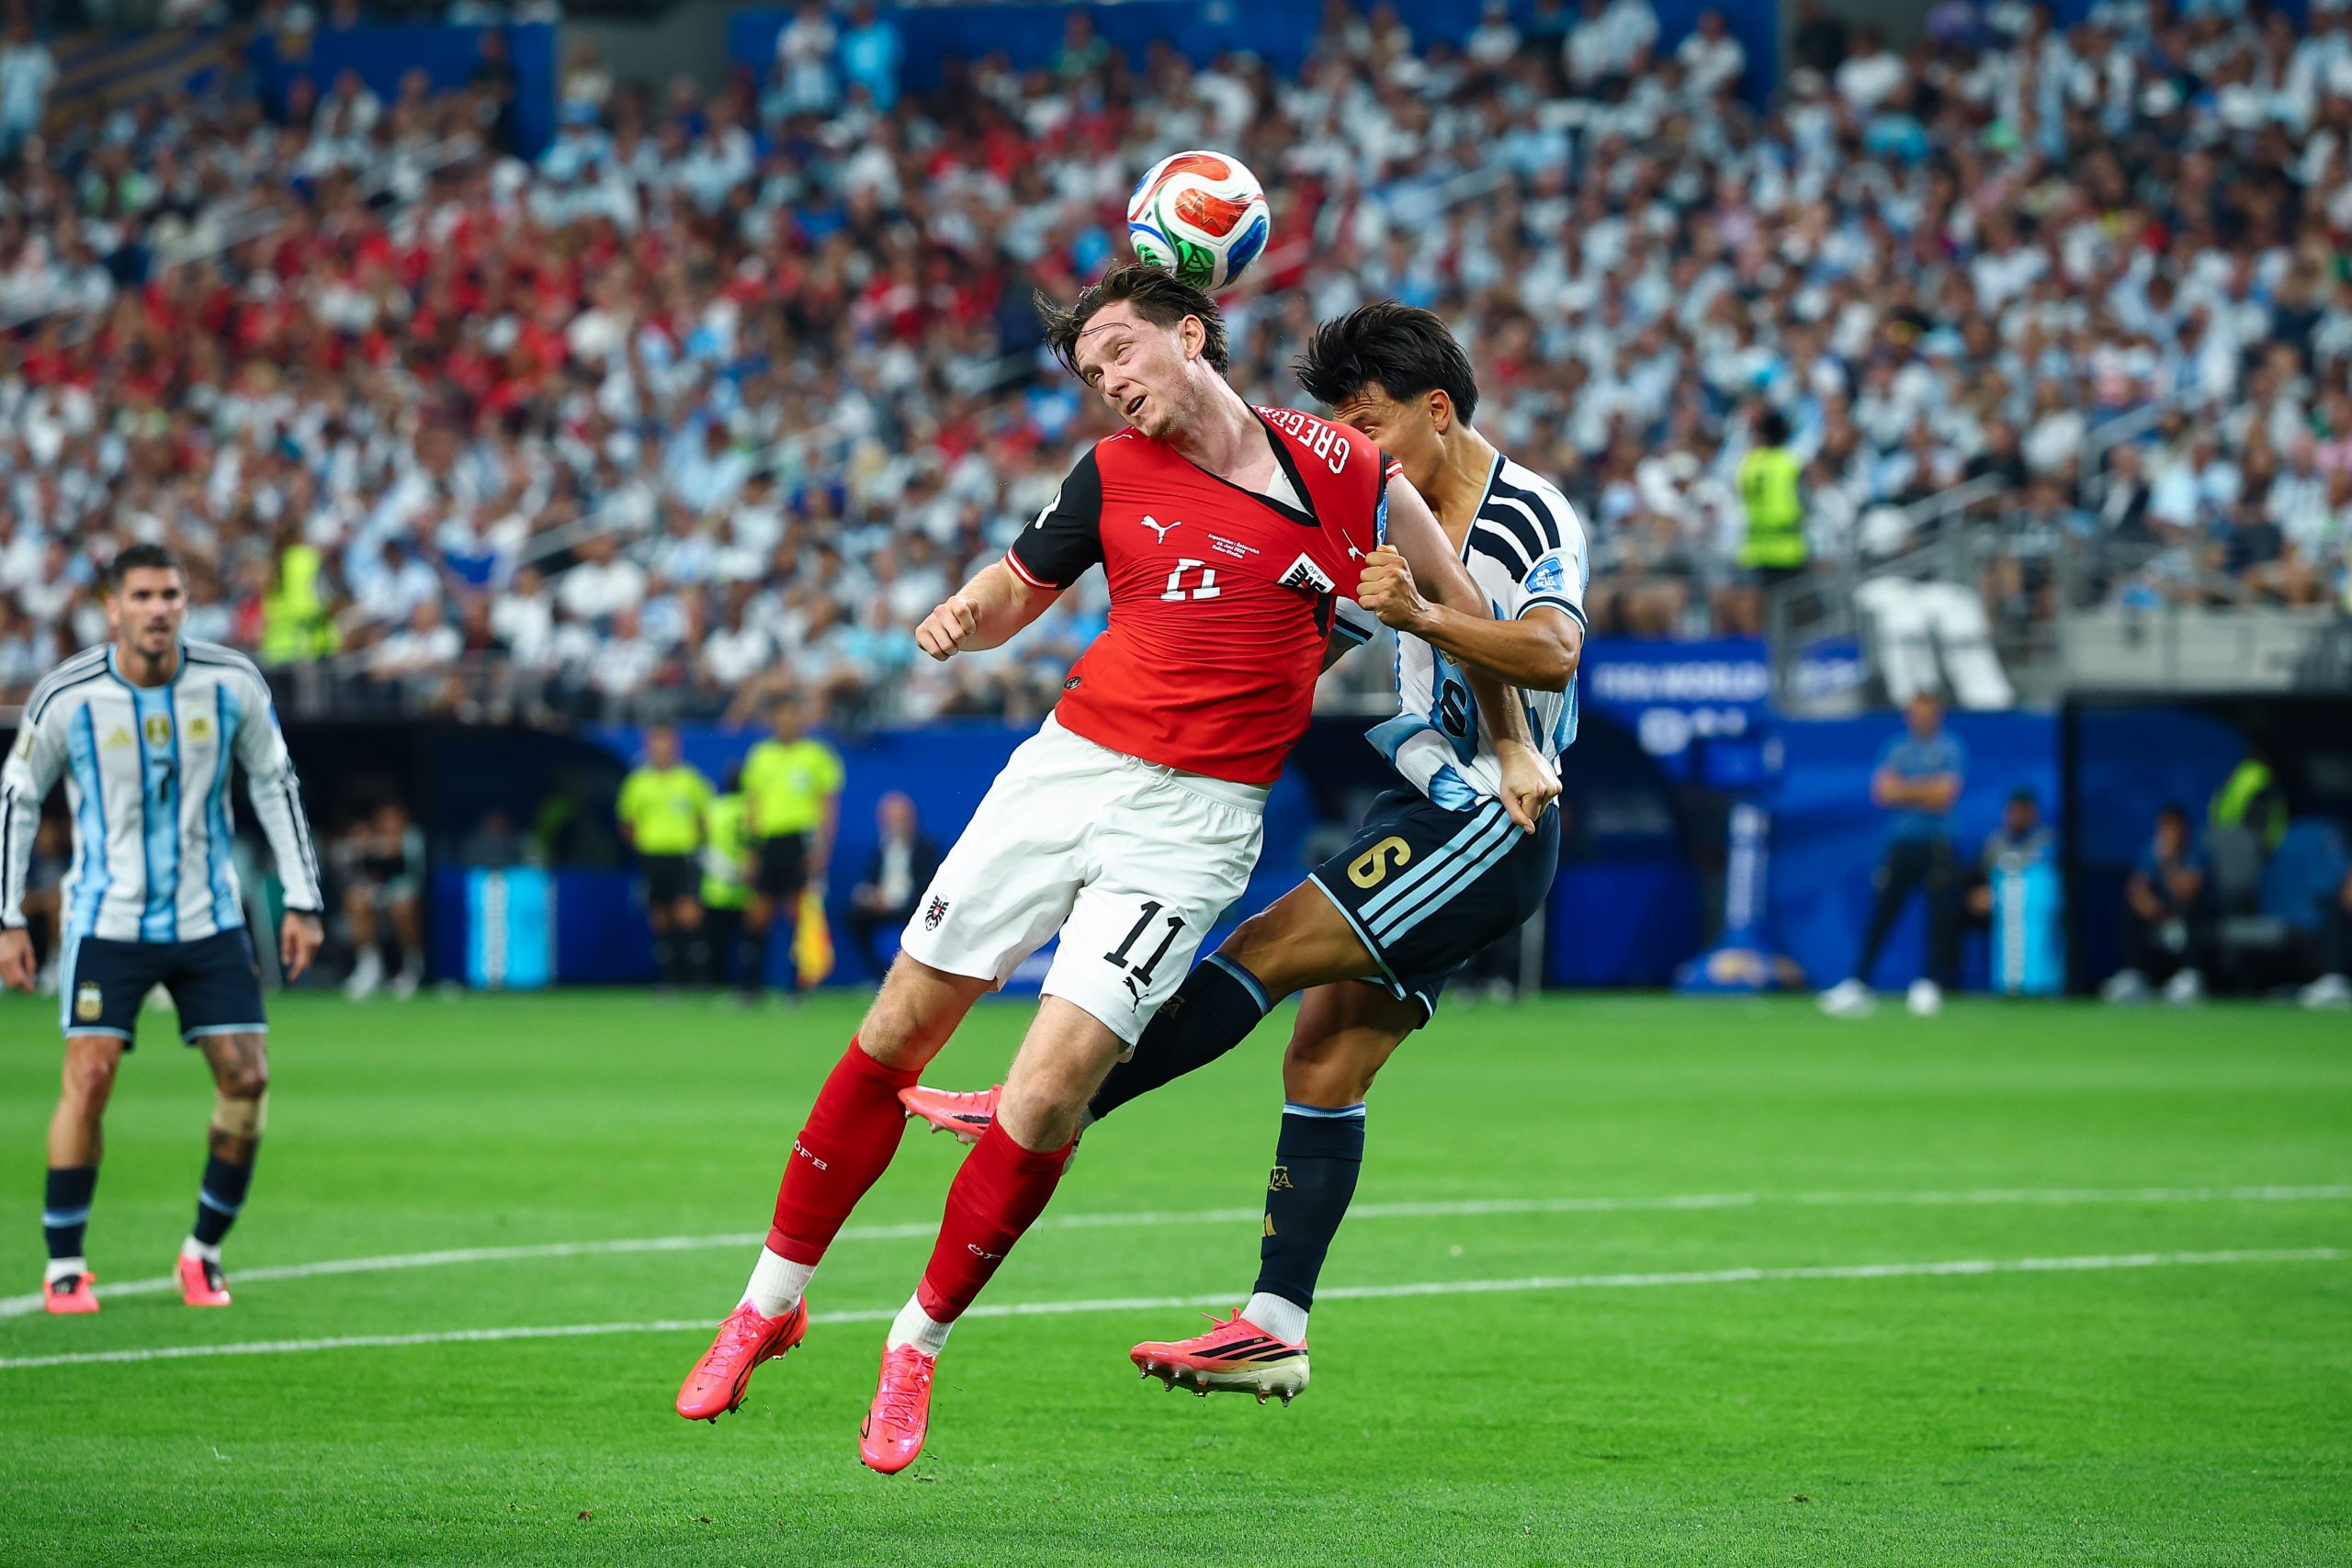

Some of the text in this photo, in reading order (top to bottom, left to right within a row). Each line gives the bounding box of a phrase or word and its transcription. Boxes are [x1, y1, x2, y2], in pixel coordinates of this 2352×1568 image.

[152, 758, 176, 805] 7
[1347, 836, 1412, 890] 6
[1102, 900, 1188, 988] 11
[967, 1243, 1005, 1259] ÖF
